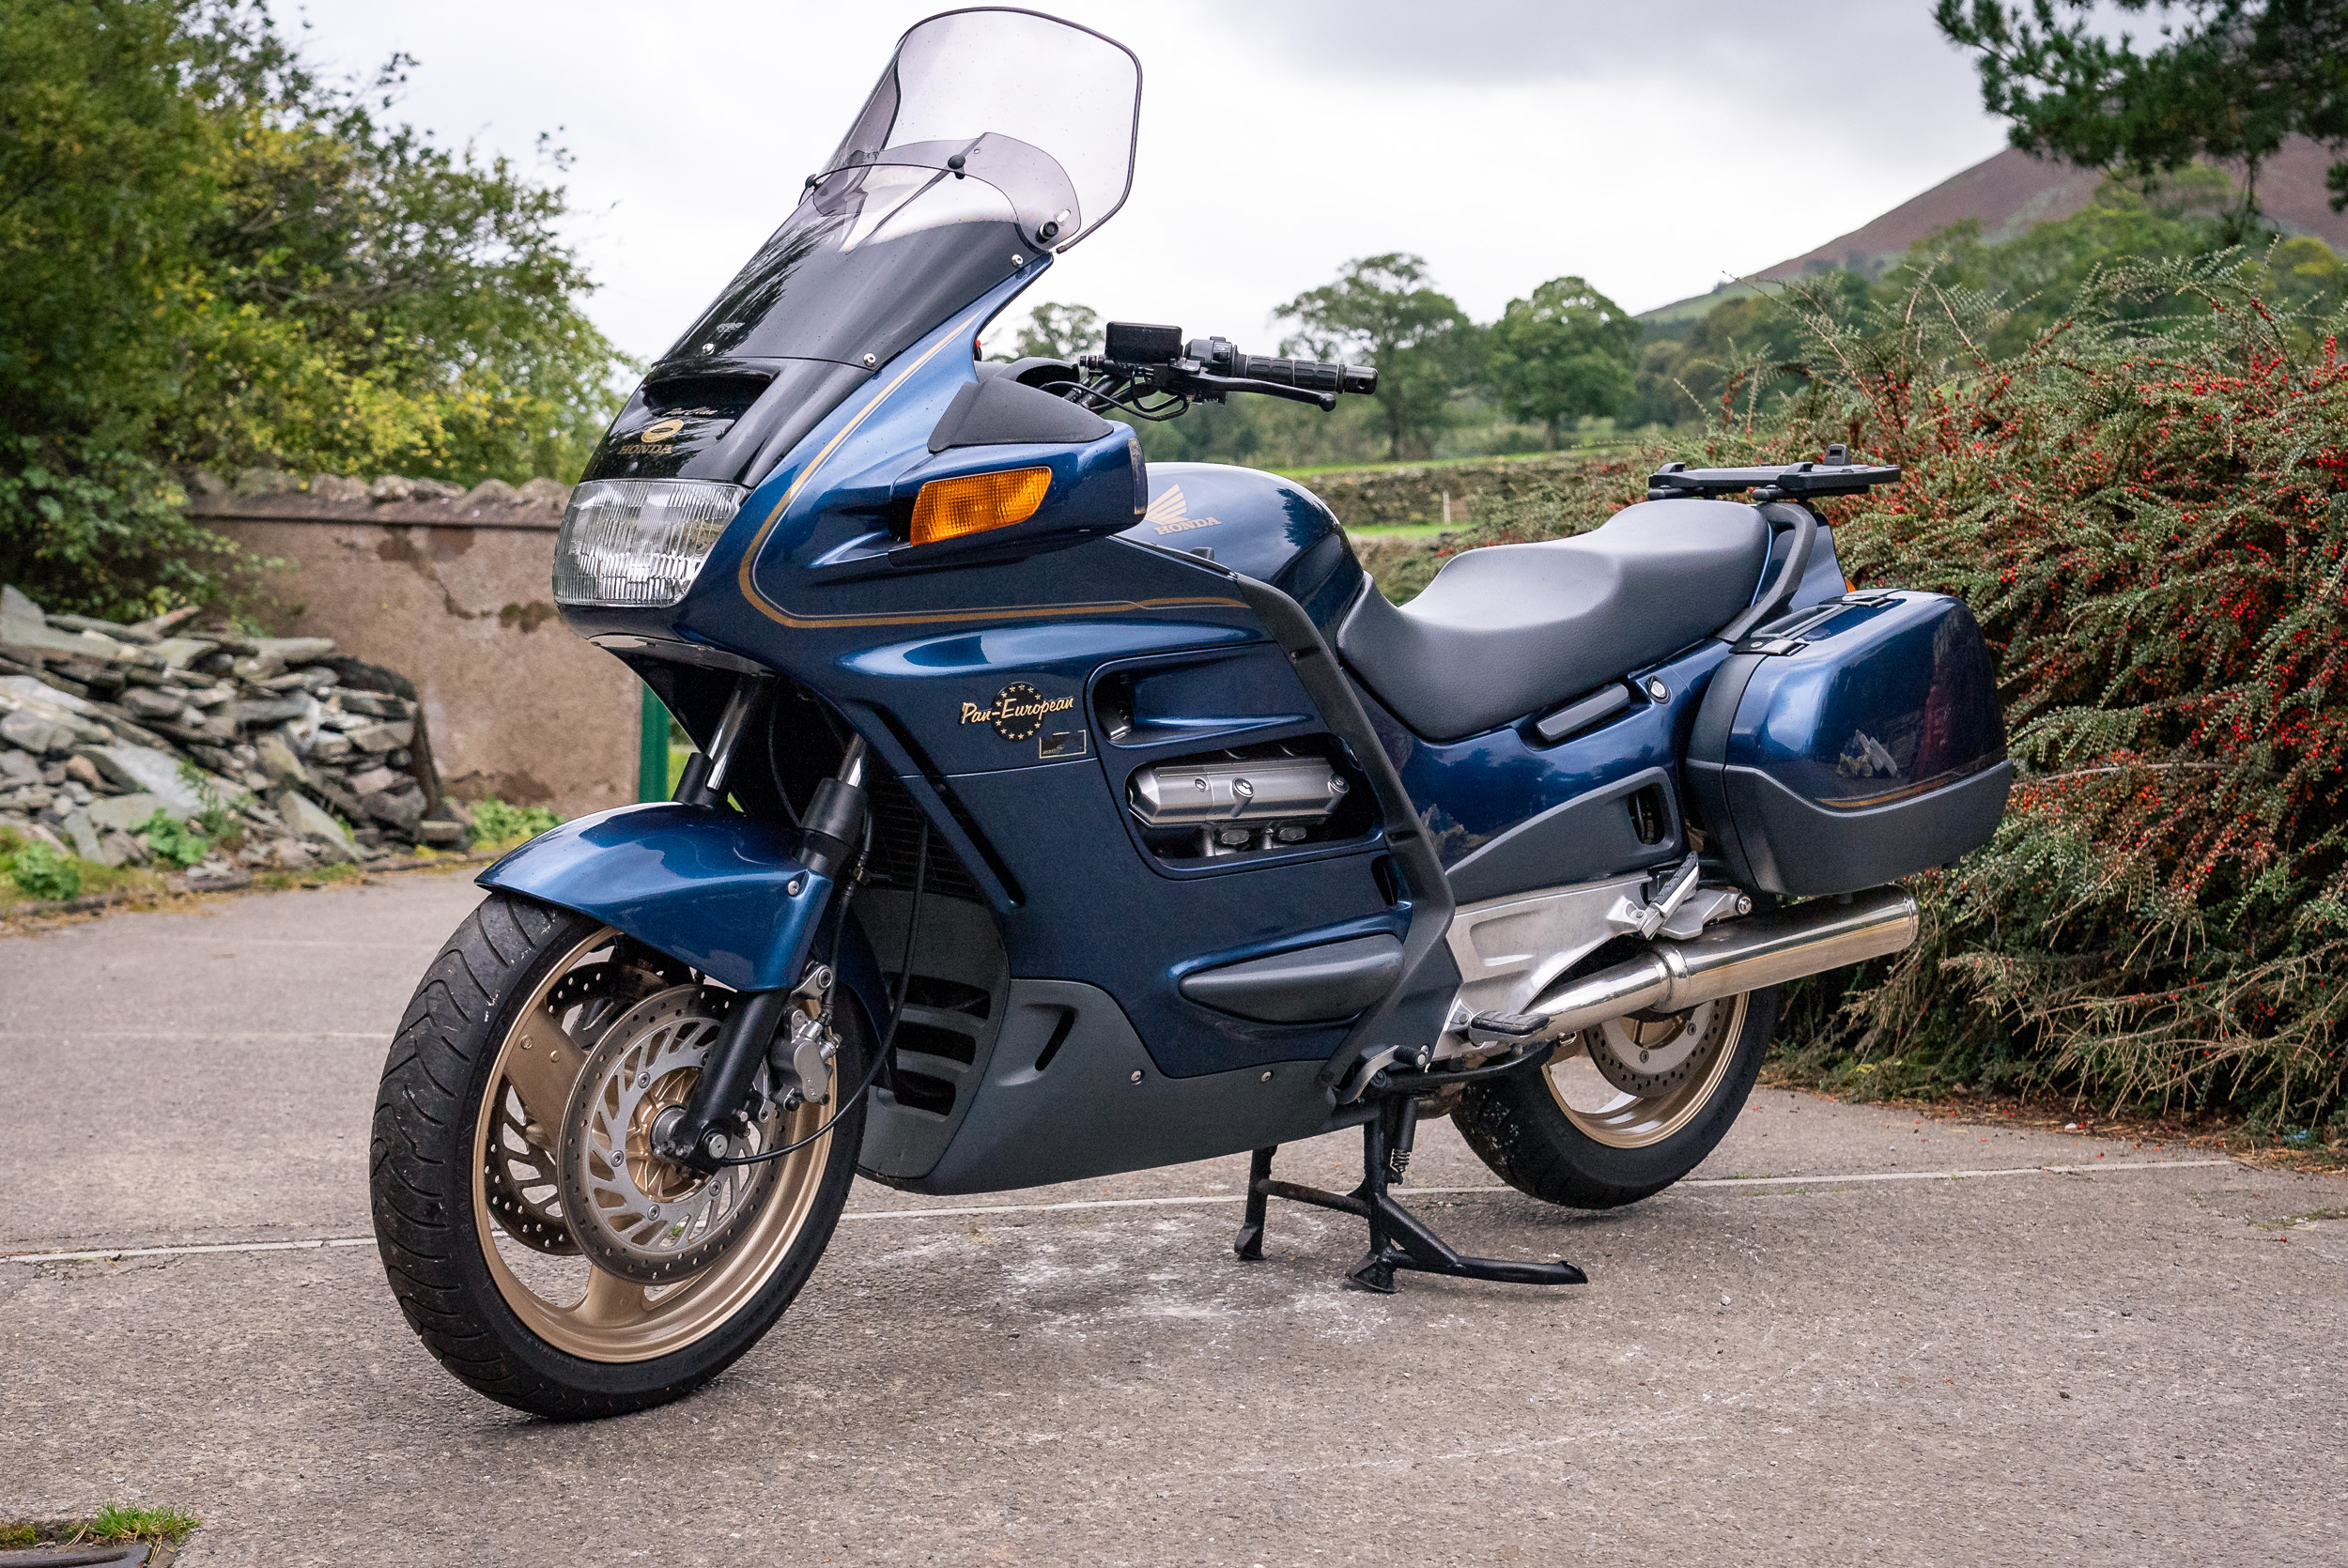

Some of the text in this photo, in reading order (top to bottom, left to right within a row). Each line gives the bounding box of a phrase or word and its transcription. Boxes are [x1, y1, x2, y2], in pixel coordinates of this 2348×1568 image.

[617, 444, 672, 455] HONDA
[1152, 516, 1223, 536] HONDA
[961, 697, 1074, 725] Pan-European
